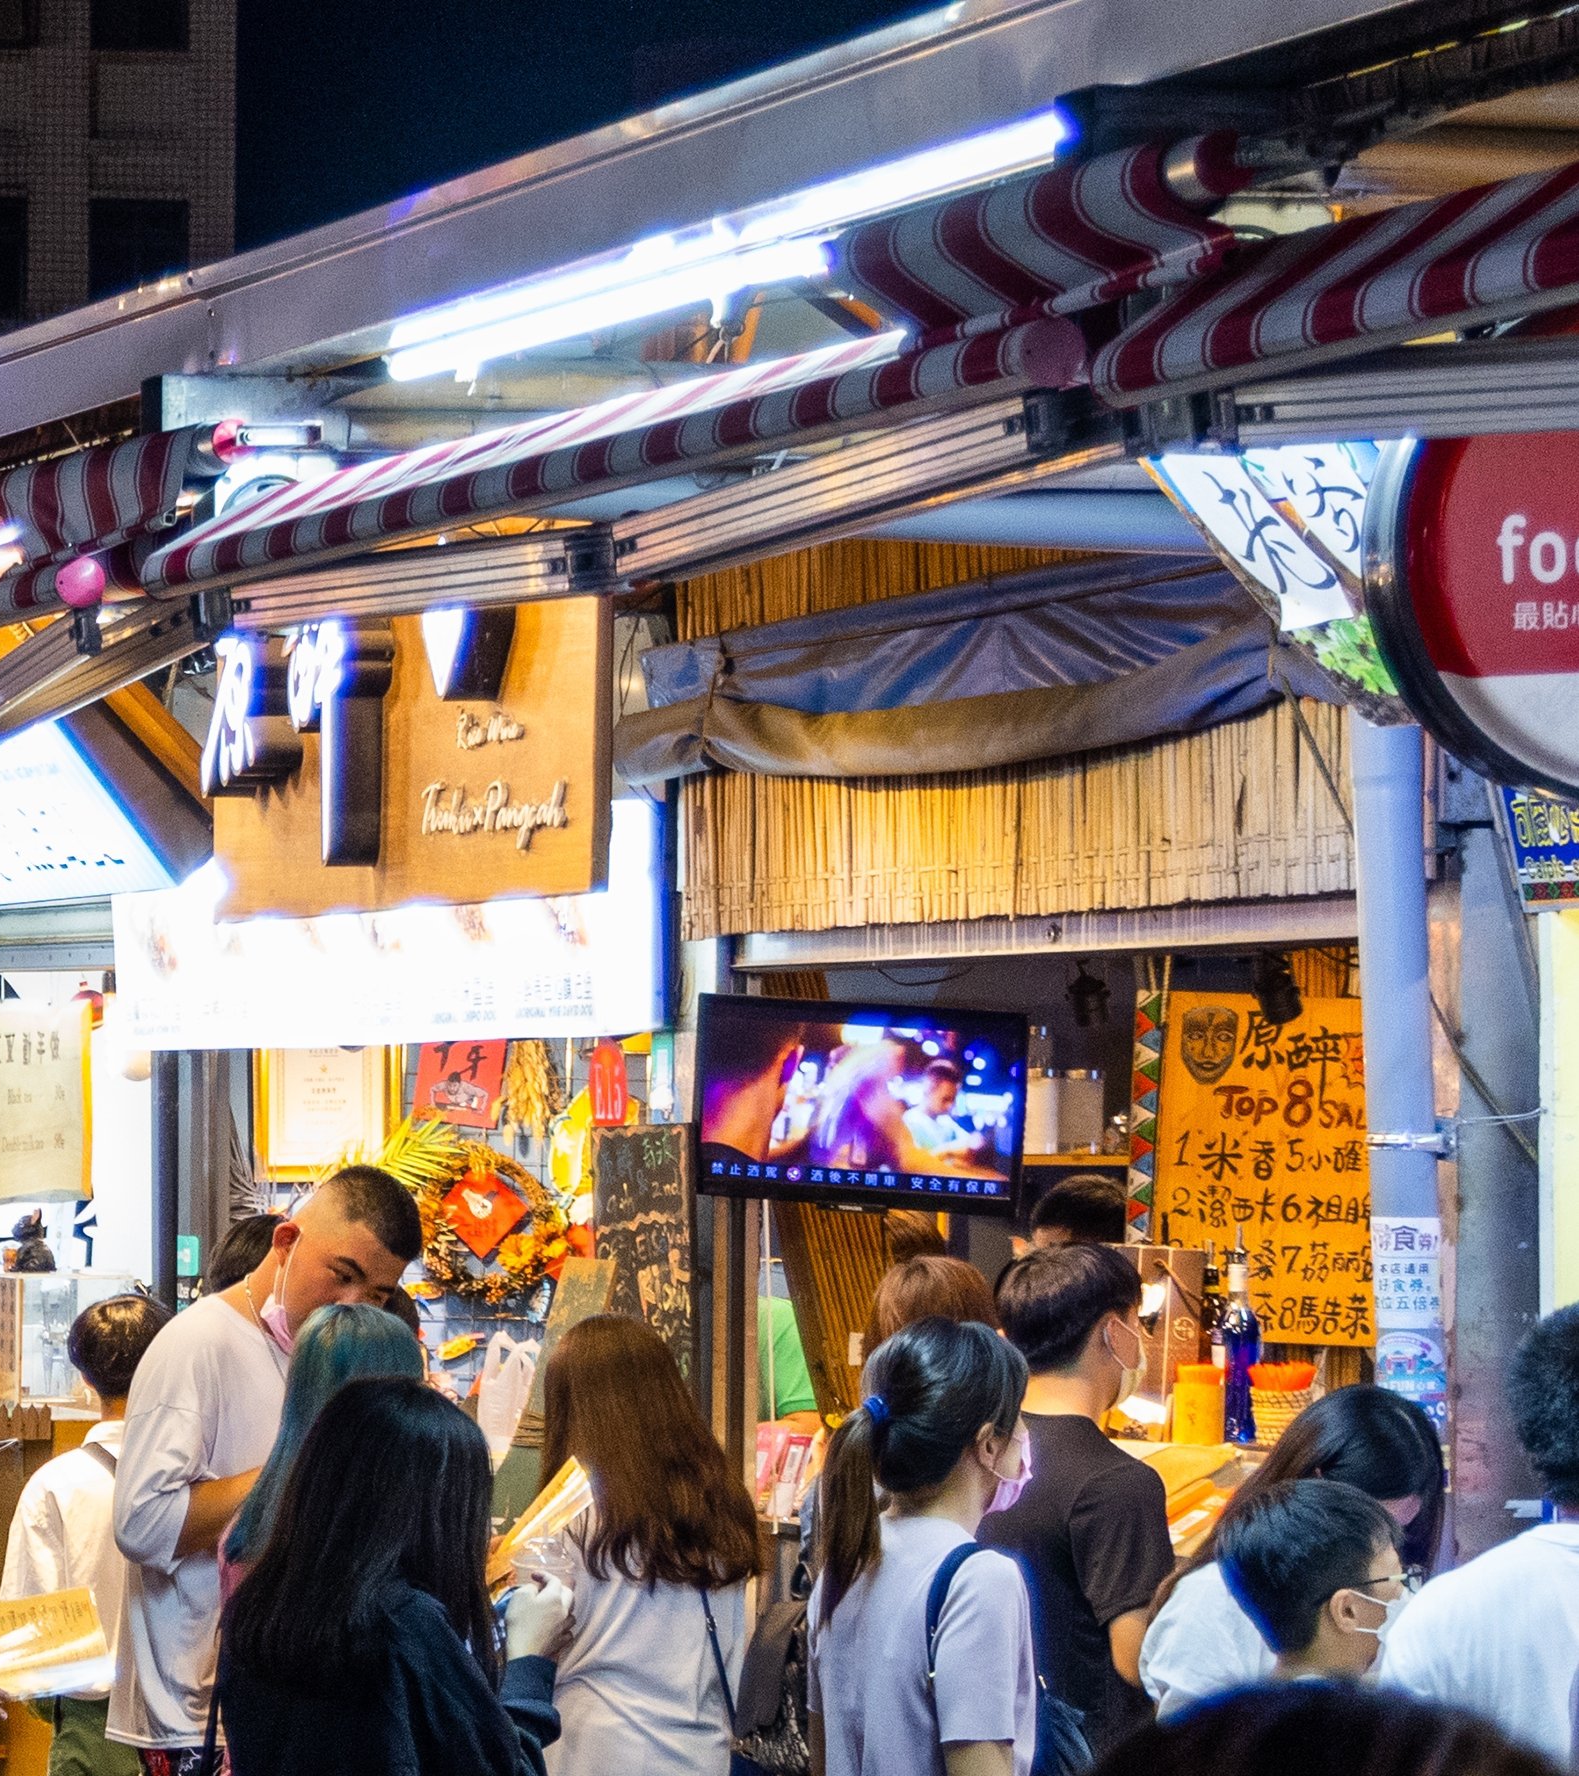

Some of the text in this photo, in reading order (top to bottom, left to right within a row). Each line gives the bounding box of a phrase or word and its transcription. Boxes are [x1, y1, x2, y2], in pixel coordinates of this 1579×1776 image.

[1496, 513, 1579, 585] fo
[1213, 1084, 1279, 1127] Top
[1283, 1079, 1313, 1128] 8
[1197, 1130, 1277, 1182] 米香
